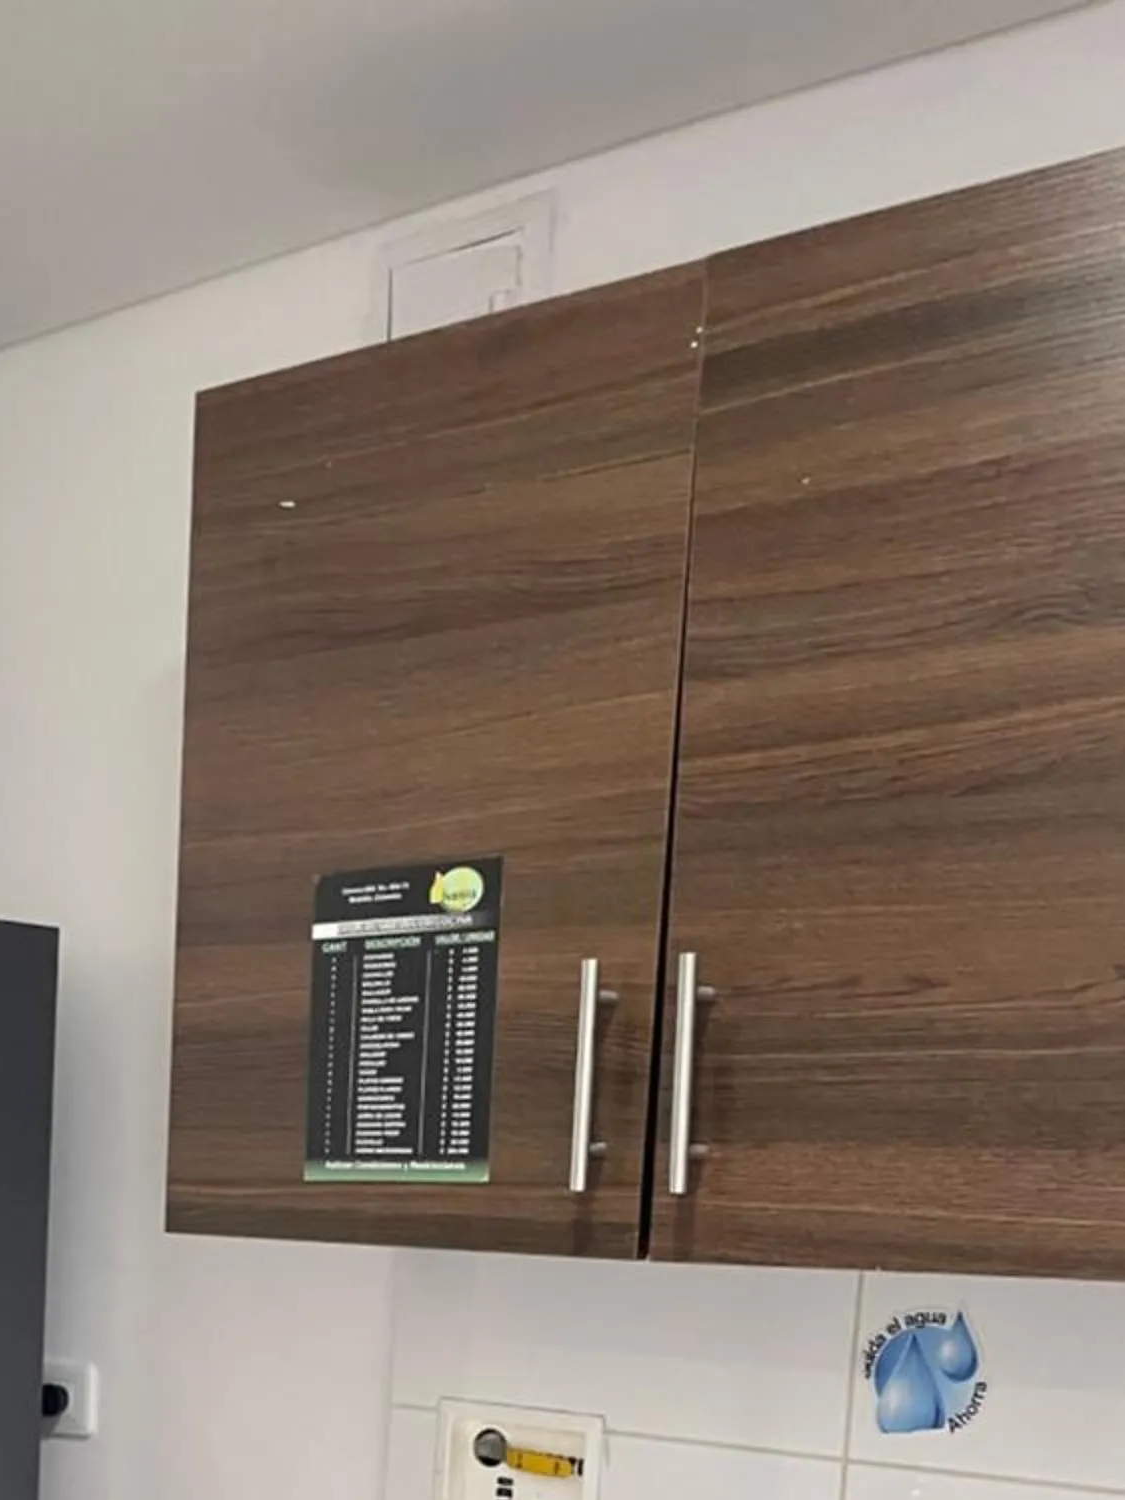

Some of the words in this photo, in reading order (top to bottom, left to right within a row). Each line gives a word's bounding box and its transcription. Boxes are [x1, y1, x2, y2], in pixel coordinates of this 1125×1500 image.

[886, 1316, 902, 1334] el
[904, 1312, 947, 1329] agua
[948, 1381, 988, 1434] Ahorra
